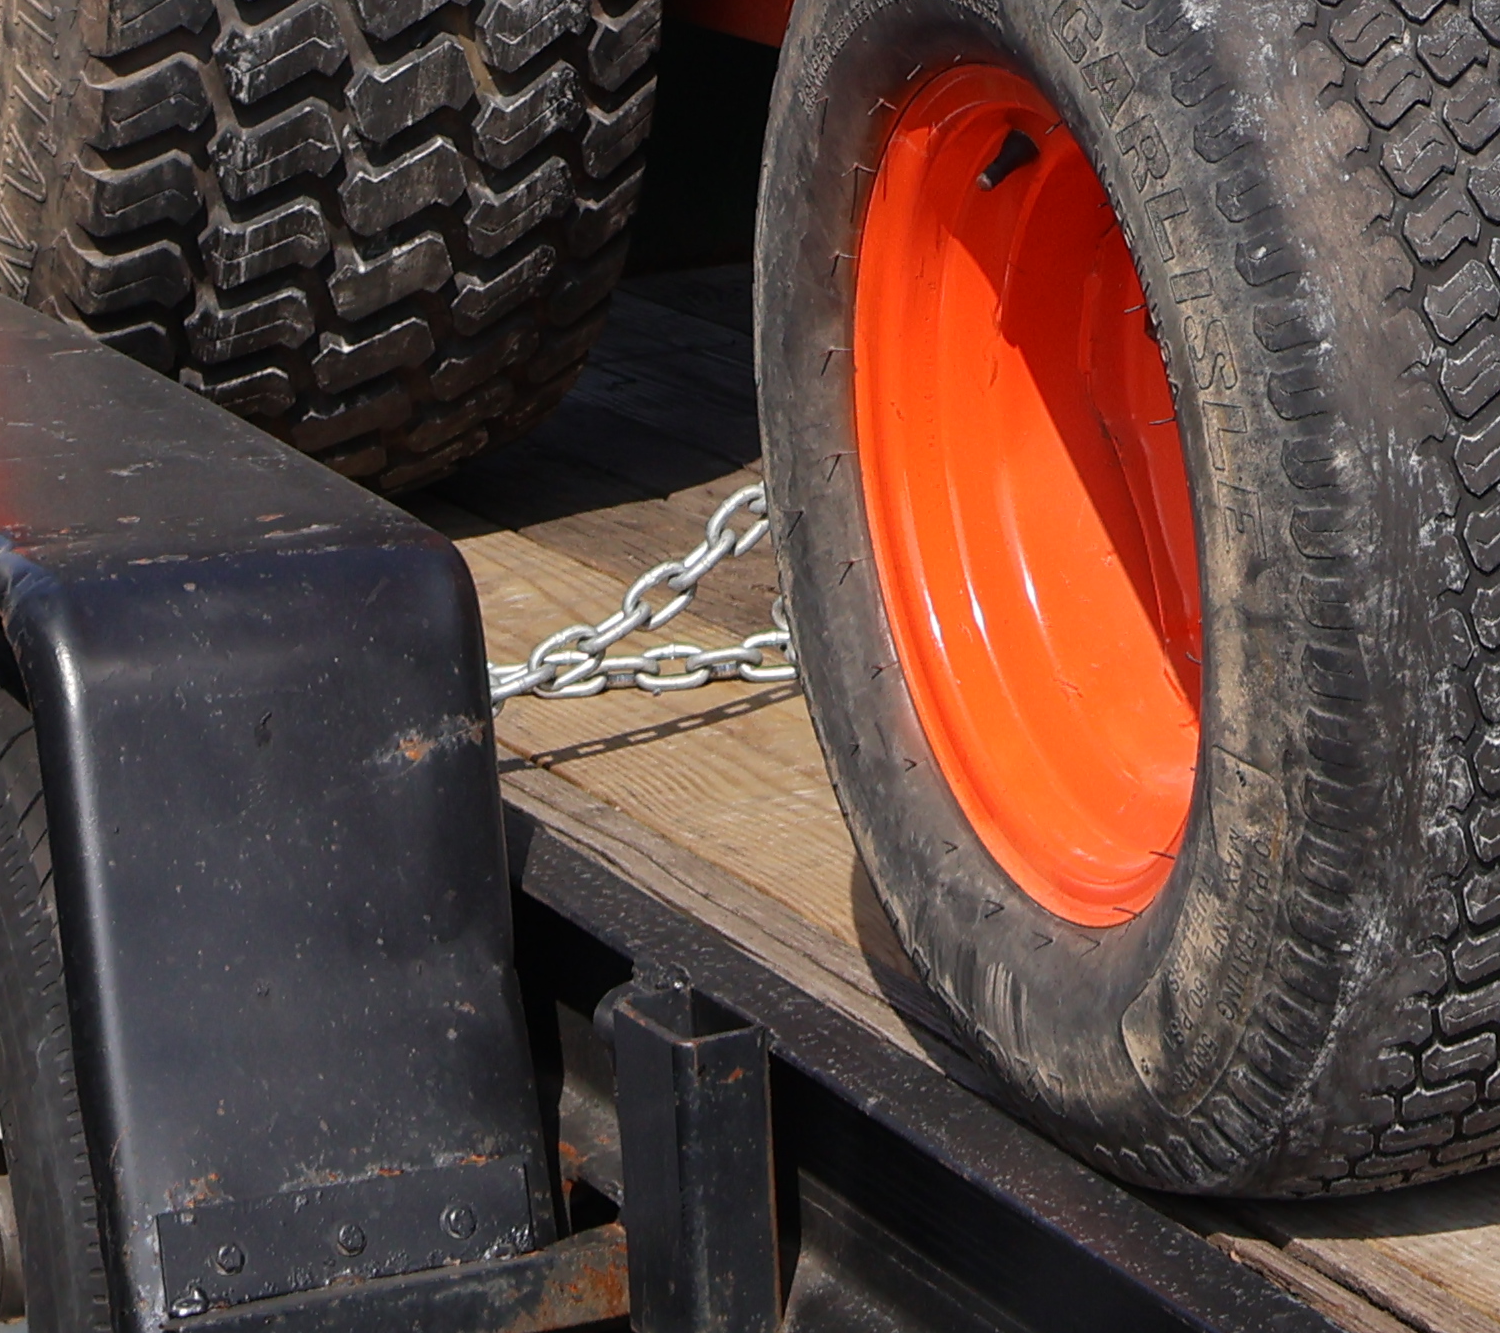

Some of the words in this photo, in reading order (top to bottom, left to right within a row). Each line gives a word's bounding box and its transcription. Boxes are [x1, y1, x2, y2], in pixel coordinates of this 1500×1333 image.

[1224, 826, 1243, 894] MAX
[1245, 867, 1269, 924] PLY
[1189, 977, 1209, 1010] 60
[1215, 929, 1258, 1022] RATING
